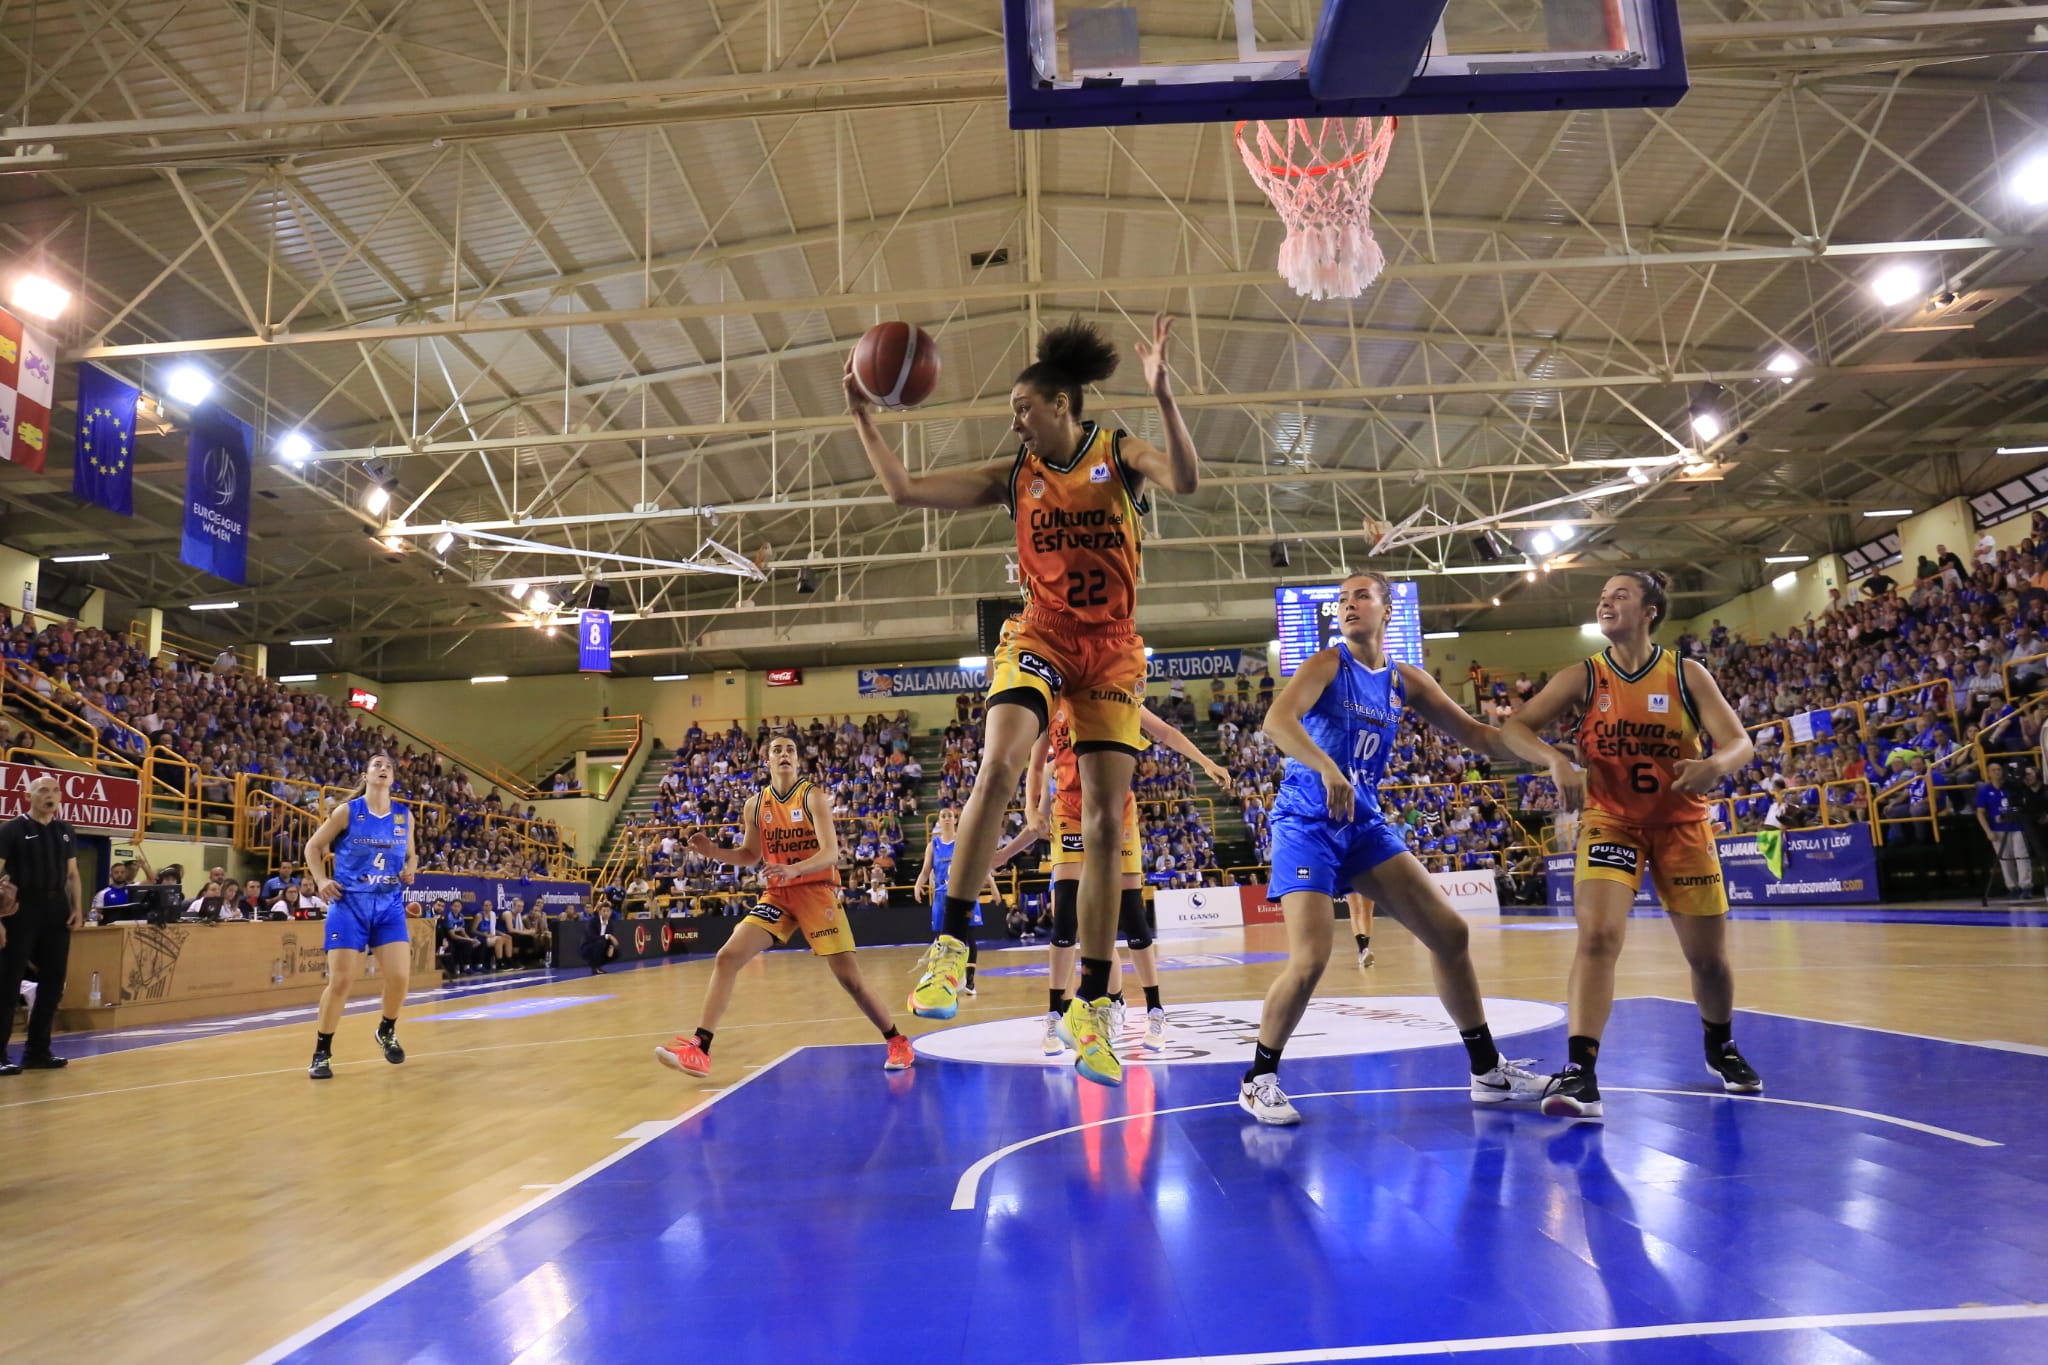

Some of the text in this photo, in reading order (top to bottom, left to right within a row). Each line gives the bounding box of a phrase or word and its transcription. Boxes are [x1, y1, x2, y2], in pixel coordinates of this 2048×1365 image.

[1031, 507, 1124, 531] Cultura del
[1032, 529, 1125, 553] Esfuerzo
[1067, 568, 1108, 608] 22
[590, 623, 601, 645] 8
[1168, 655, 1234, 678] EUROPA
[1594, 719, 1683, 740] Cultura del
[1354, 729, 1380, 761] 10
[1597, 739, 1681, 759] Esfuerzo
[1631, 763, 1659, 794] 6
[1591, 845, 1635, 860] PULEVA
[1822, 837, 1829, 851] Y
[373, 852, 386, 871] 4
[1440, 881, 1493, 897] VLON
[1673, 872, 1721, 886] zummo
[1190, 913, 1219, 921] GANSO
[810, 927, 839, 939] zummo
